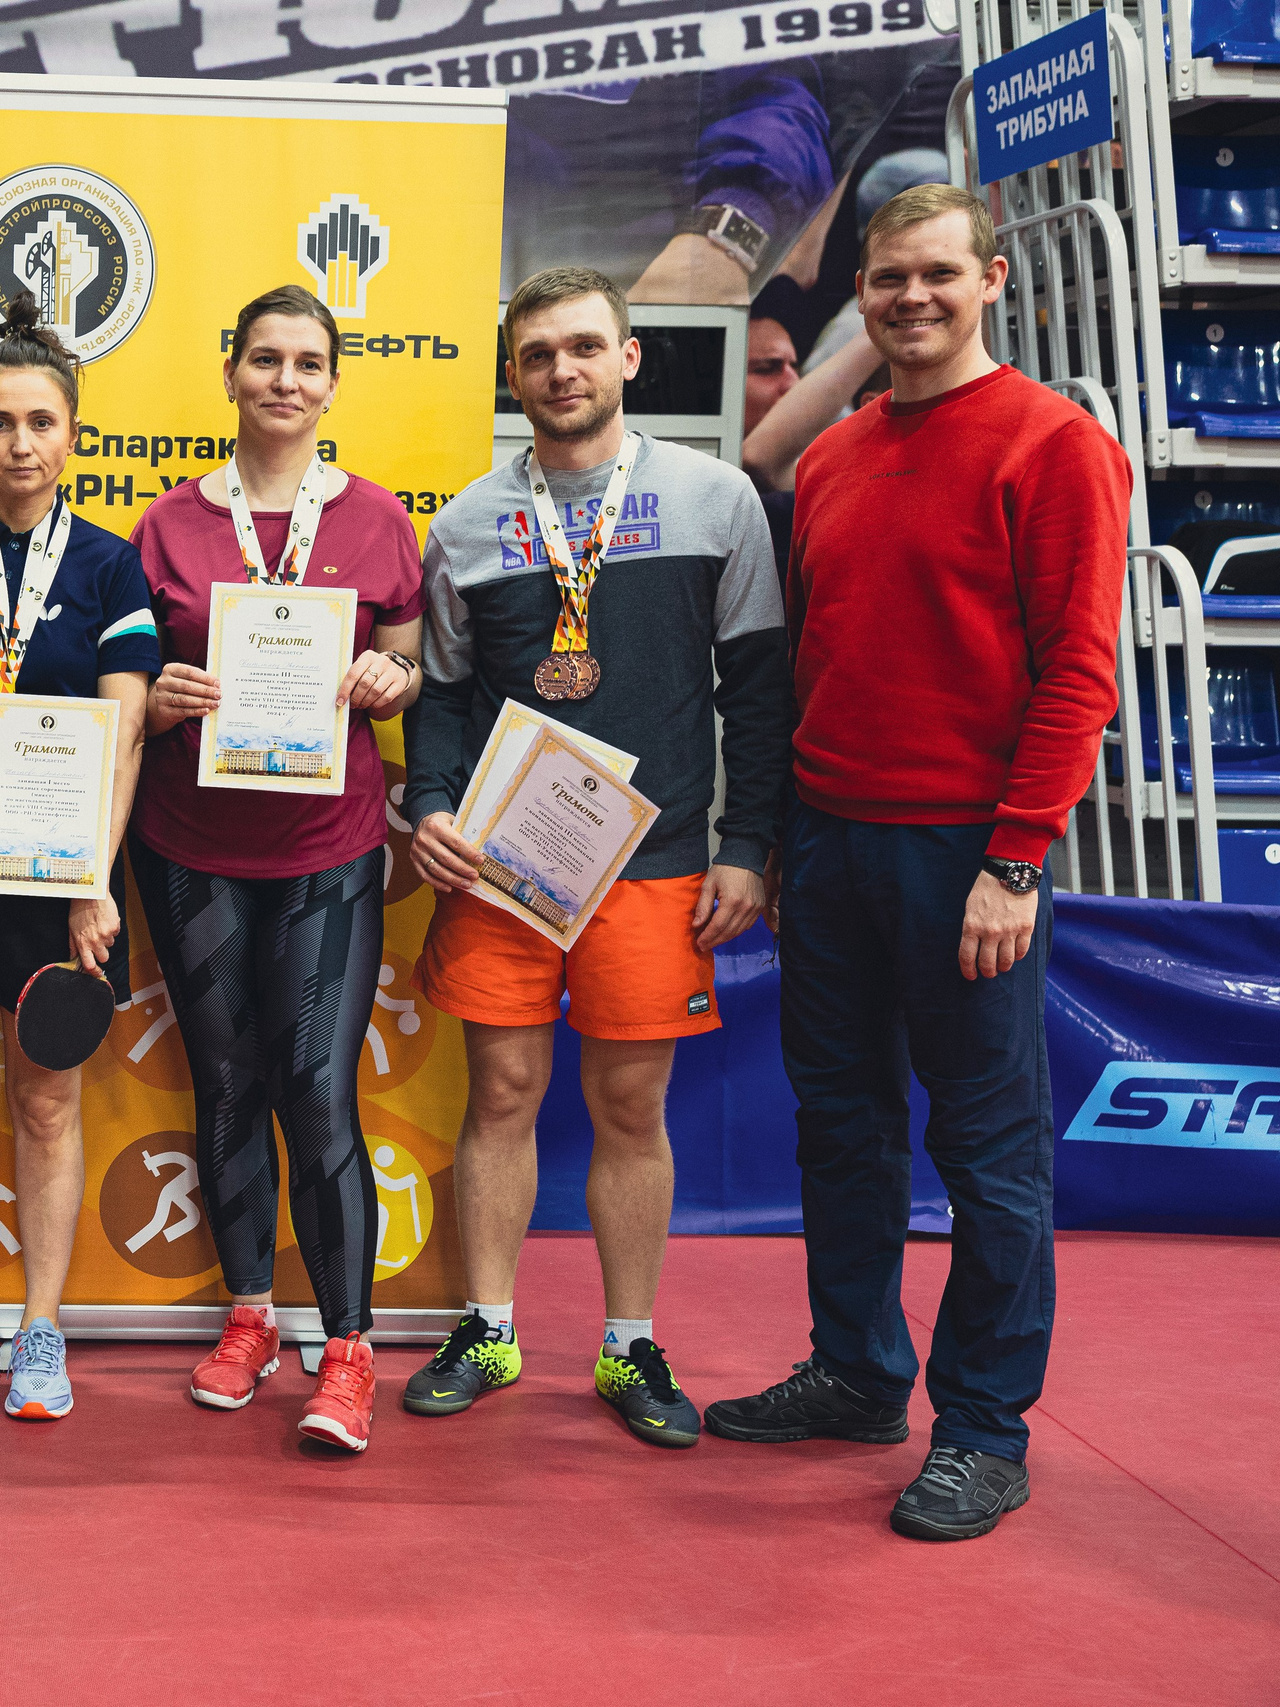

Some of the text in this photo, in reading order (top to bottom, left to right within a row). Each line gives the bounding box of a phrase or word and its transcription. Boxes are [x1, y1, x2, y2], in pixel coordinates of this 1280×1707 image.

[334, 0, 926, 87] СНОВАН 1999
[986, 40, 1096, 114] ЗАПАДНАЯ
[996, 89, 1090, 150] ТРИБУНА
[61, 177, 137, 237] ОРГАНИЗАЦИЯ
[131, 239, 144, 266] ПАО
[97, 255, 123, 317] РОССИИ
[75, 297, 136, 352] «РОСНЕФТЬ»
[221, 329, 459, 360] РЕФТЬ
[75, 425, 337, 467] Спартака
[586, 492, 659, 525] SAR
[582, 533, 640, 549] AELES
[505, 558, 521, 567] NBA
[249, 633, 313, 648] Грамота
[14, 741, 76, 756] Грамота
[551, 781, 604, 827] Грамота
[555, 800, 591, 828] награждается
[529, 810, 557, 833] командных
[558, 832, 595, 863] соревнованиях
[532, 825, 563, 851] настольному
[564, 851, 584, 868] теннису
[538, 810, 587, 850] занявший III место
[550, 845, 583, 873] Спартакиады
